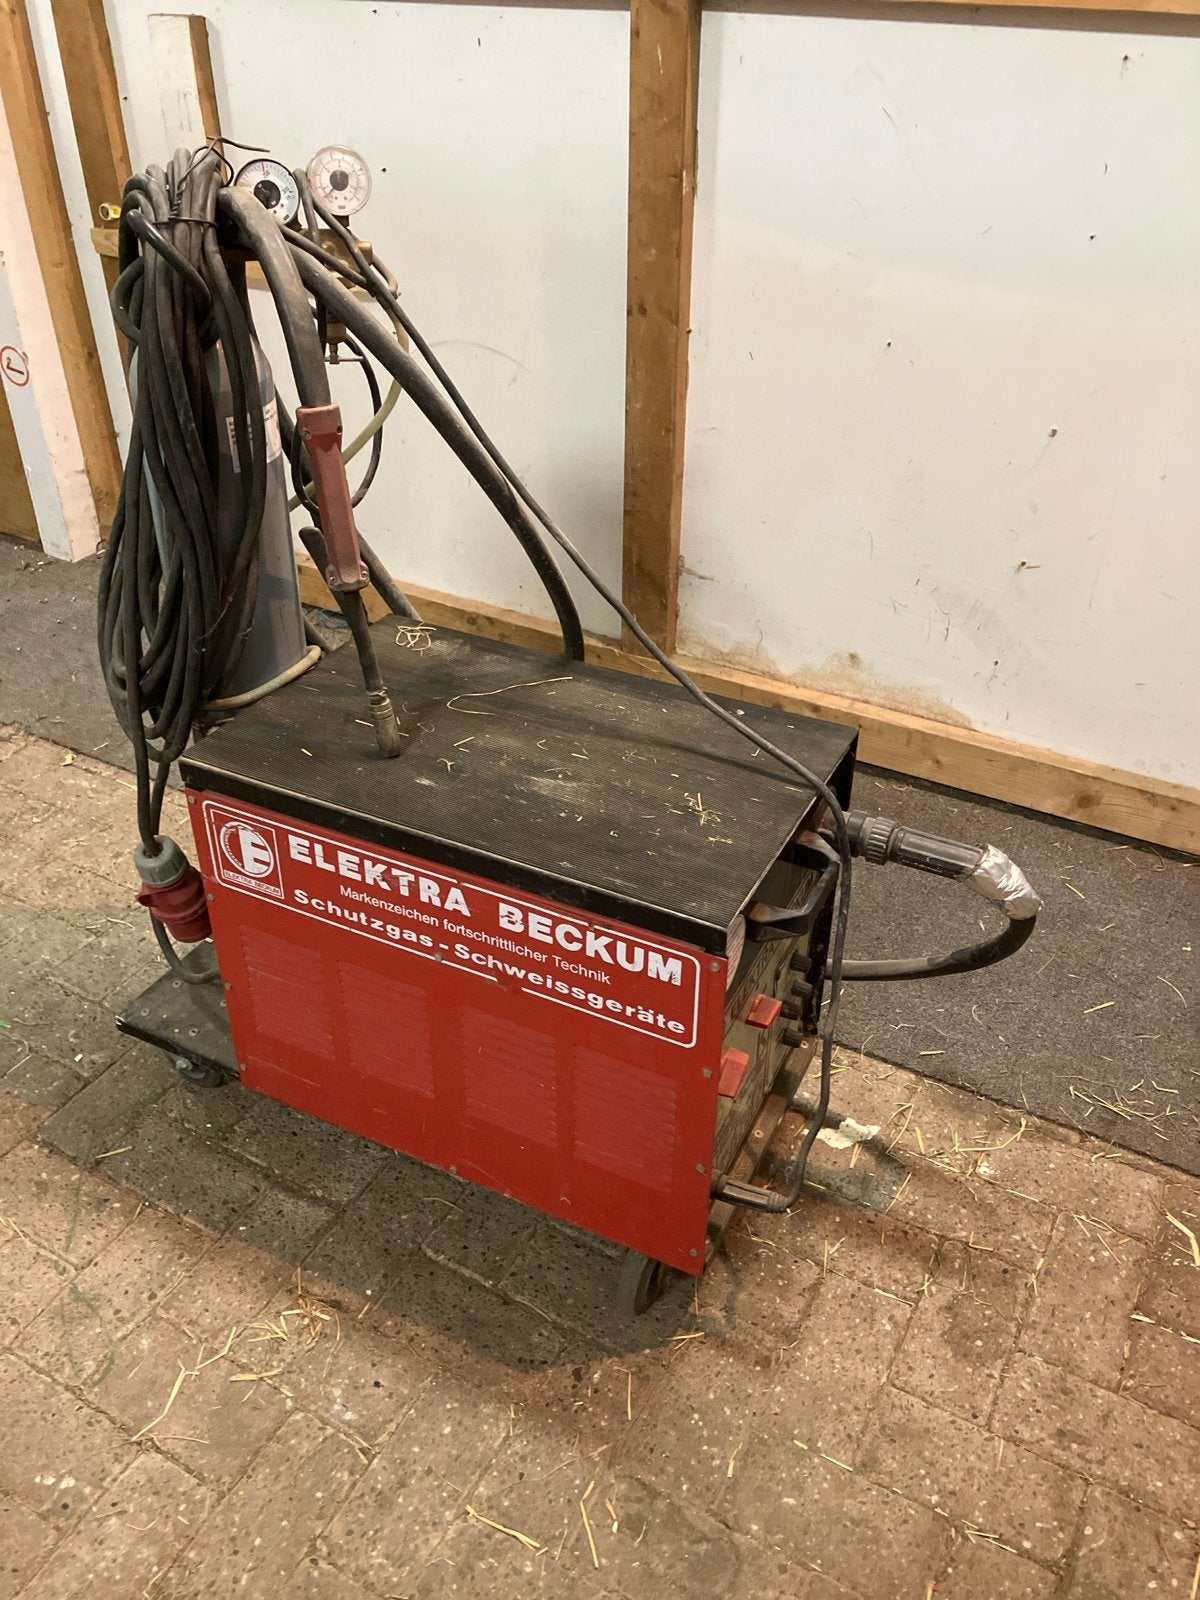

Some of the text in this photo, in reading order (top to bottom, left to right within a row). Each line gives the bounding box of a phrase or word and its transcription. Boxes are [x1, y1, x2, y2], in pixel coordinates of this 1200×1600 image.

[288, 834, 471, 917] ELEKTRA
[499, 902, 682, 986] BECKUM
[340, 885, 611, 985] Markenzeichen fortschrittlicher Technik
